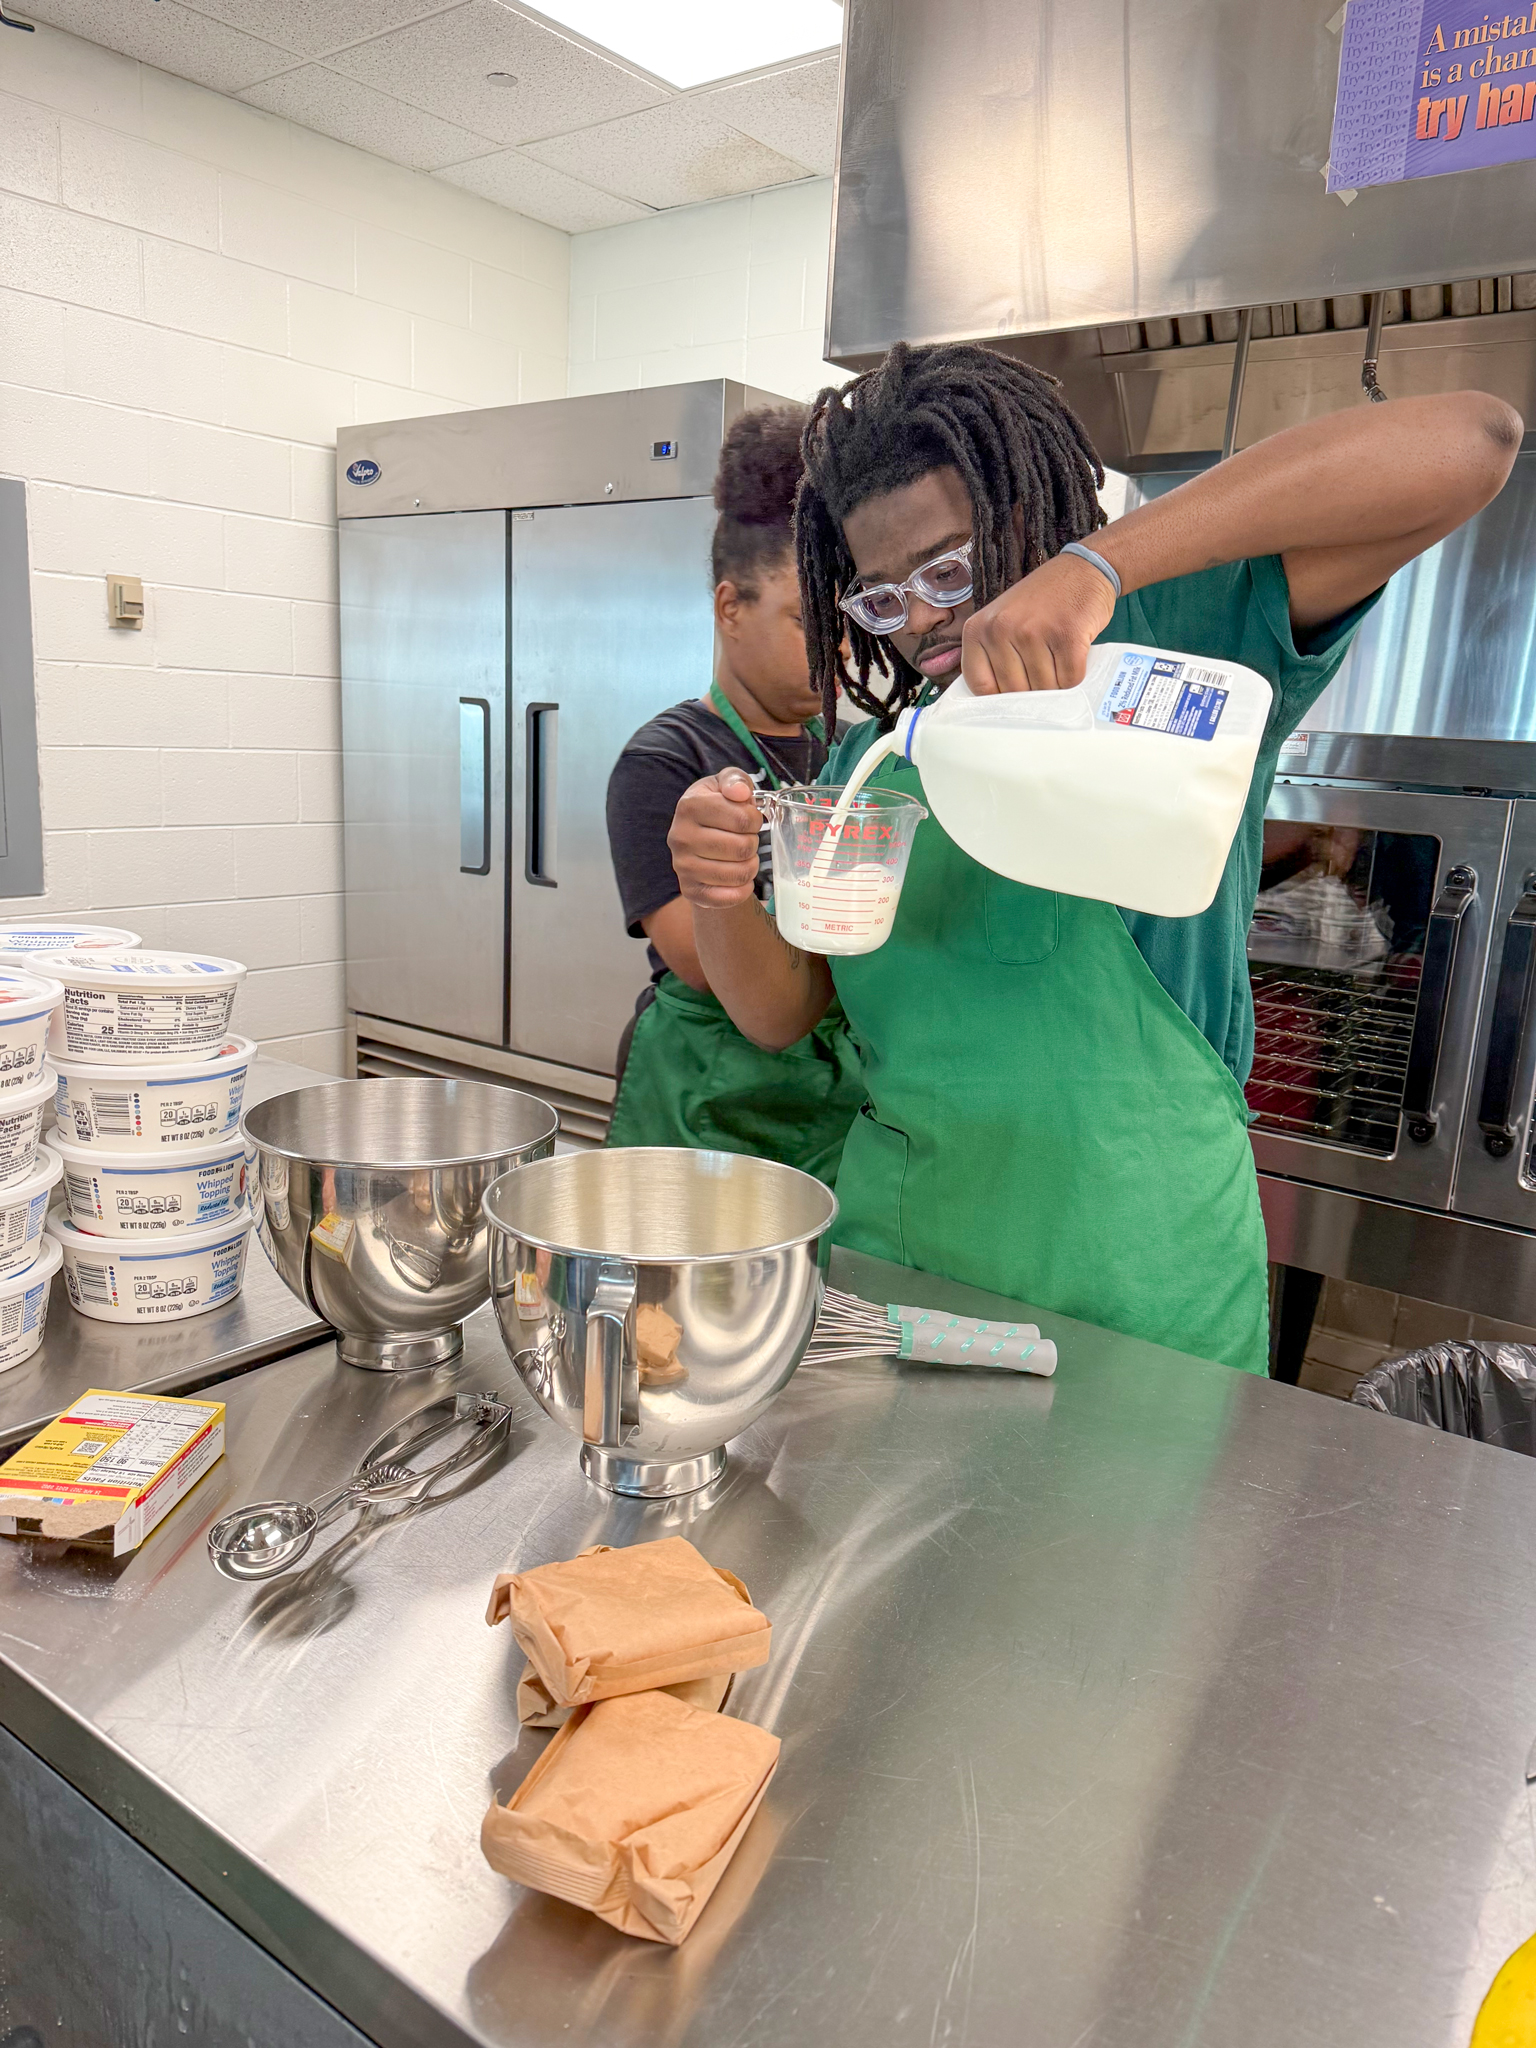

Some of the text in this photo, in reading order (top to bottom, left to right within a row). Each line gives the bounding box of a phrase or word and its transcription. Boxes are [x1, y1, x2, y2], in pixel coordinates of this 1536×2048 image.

[1423, 24, 1448, 56] A
[1420, 60, 1441, 89] is
[1447, 64, 1463, 84] a
[1416, 94, 1469, 142] try
[809, 821, 893, 840] PYREX
[798, 880, 810, 888] 250
[798, 902, 810, 910] 150
[824, 923, 854, 932] METRIC
[65, 988, 105, 1000] Nutrition
[65, 996, 89, 1005] Facts
[101, 1026, 114, 1034] 25
[199, 1163, 234, 1177] FOOD LION
[197, 1173, 234, 1190] Whipped
[200, 1186, 230, 1199] Topping
[212, 1250, 242, 1270] Whipped
[214, 1261, 238, 1278] Topping
[107, 1479, 144, 1488] Nutrition
